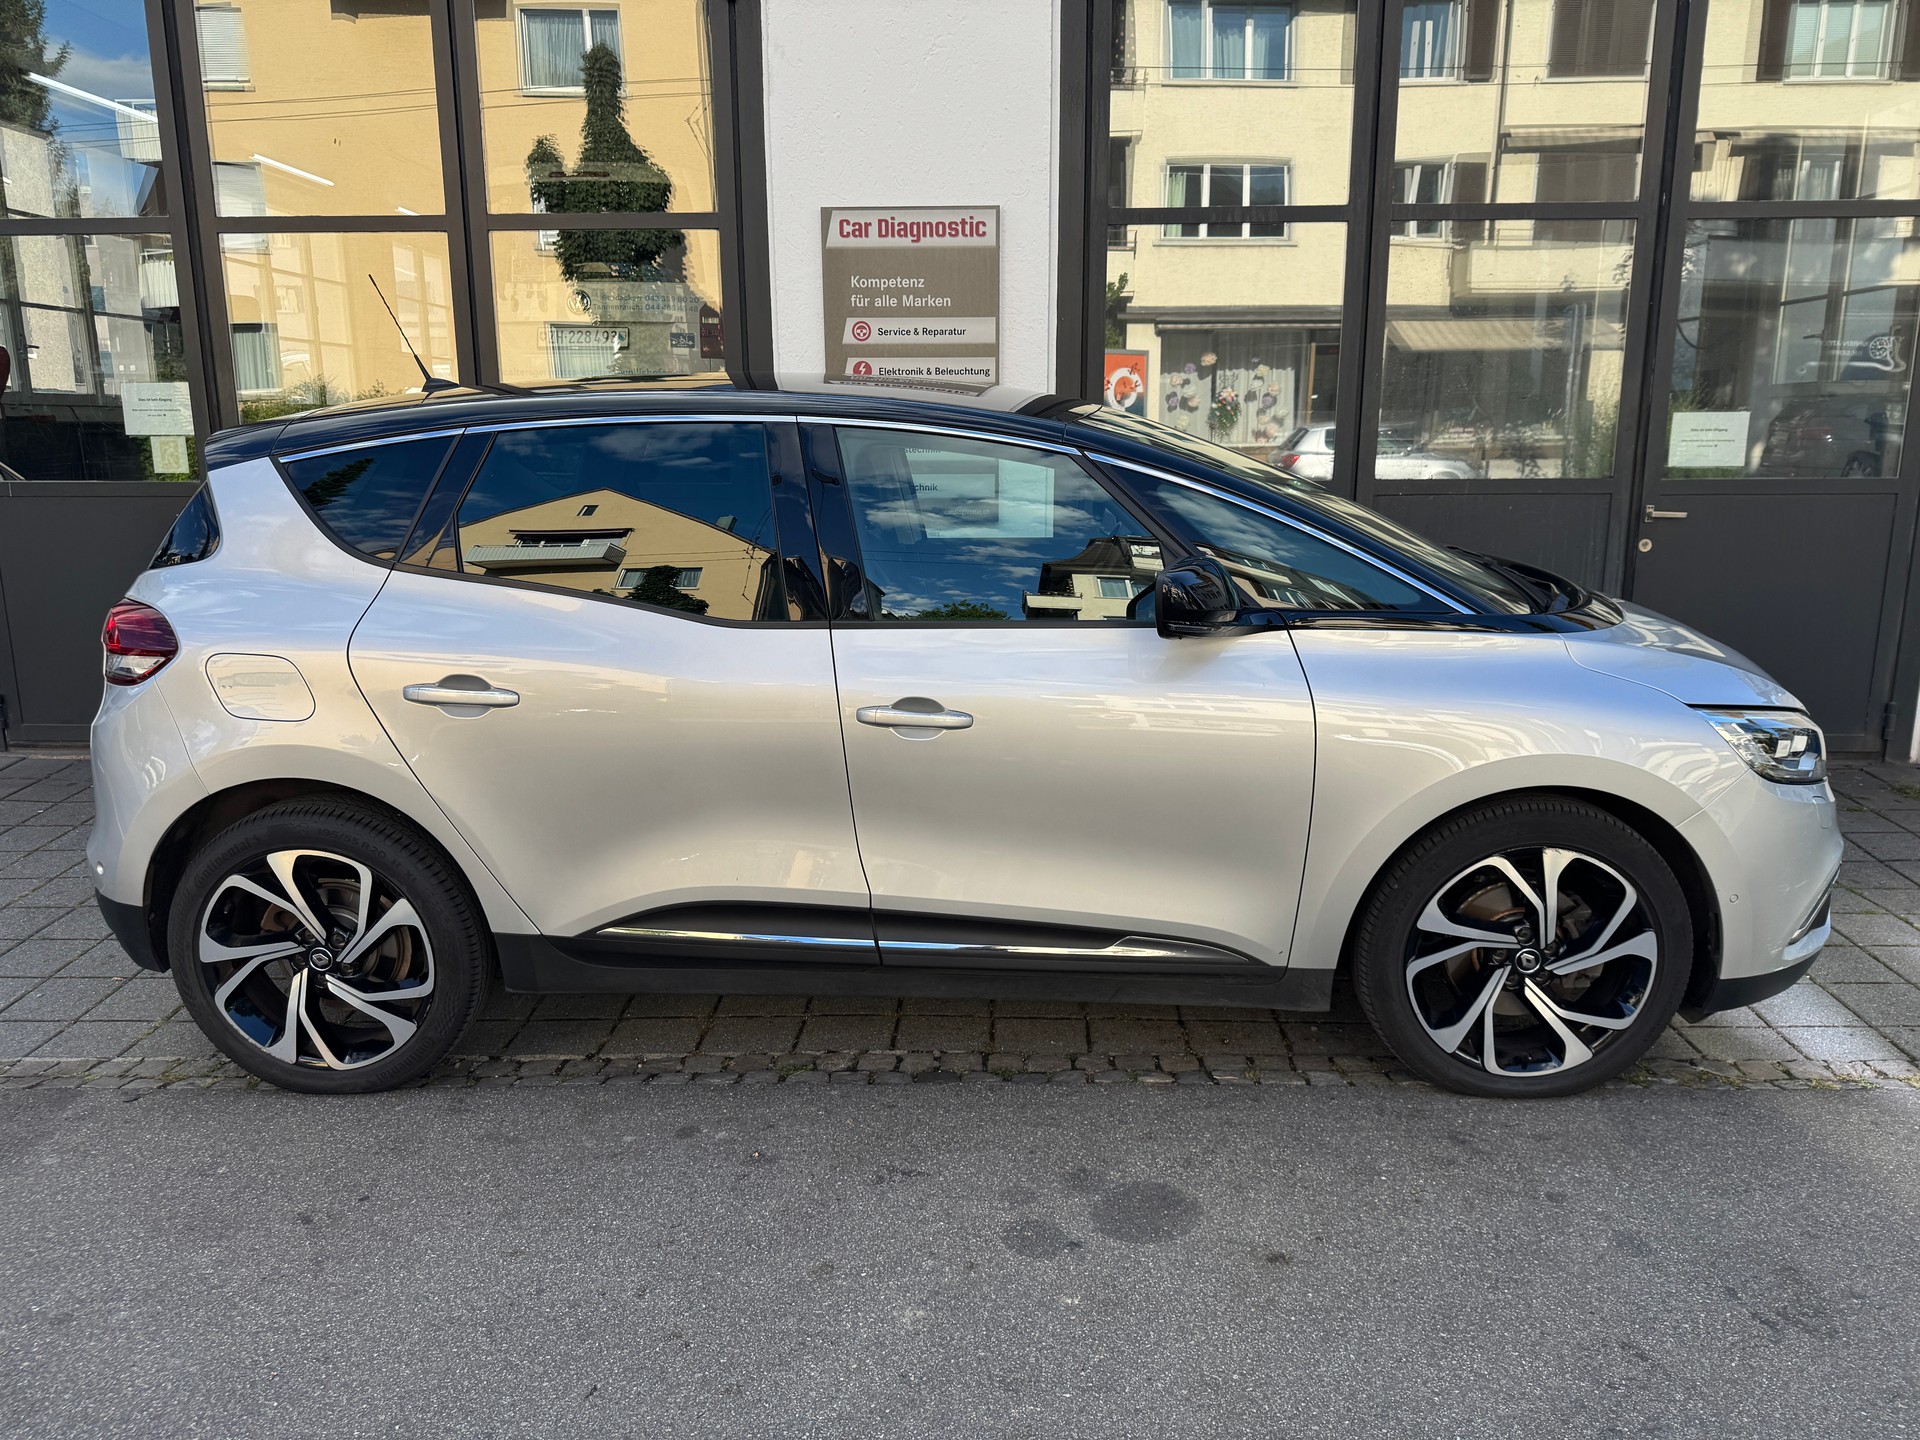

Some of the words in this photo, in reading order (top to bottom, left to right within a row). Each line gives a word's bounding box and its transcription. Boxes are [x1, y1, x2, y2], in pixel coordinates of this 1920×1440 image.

[839, 218, 872, 239] Car
[877, 216, 987, 244] Diagnostic
[851, 275, 925, 291] Kompetenz
[851, 294, 870, 307] für
[874, 294, 898, 307] alle
[902, 294, 951, 307] Marken
[877, 327, 911, 336] Service
[913, 327, 920, 336] &
[922, 327, 966, 338] Reparatur
[878, 367, 924, 376] Elektronik
[926, 367, 932, 376] &
[935, 367, 991, 378] Beleuchtung
[914, 483, 938, 491] chnik
[194, 837, 253, 889] Continental
